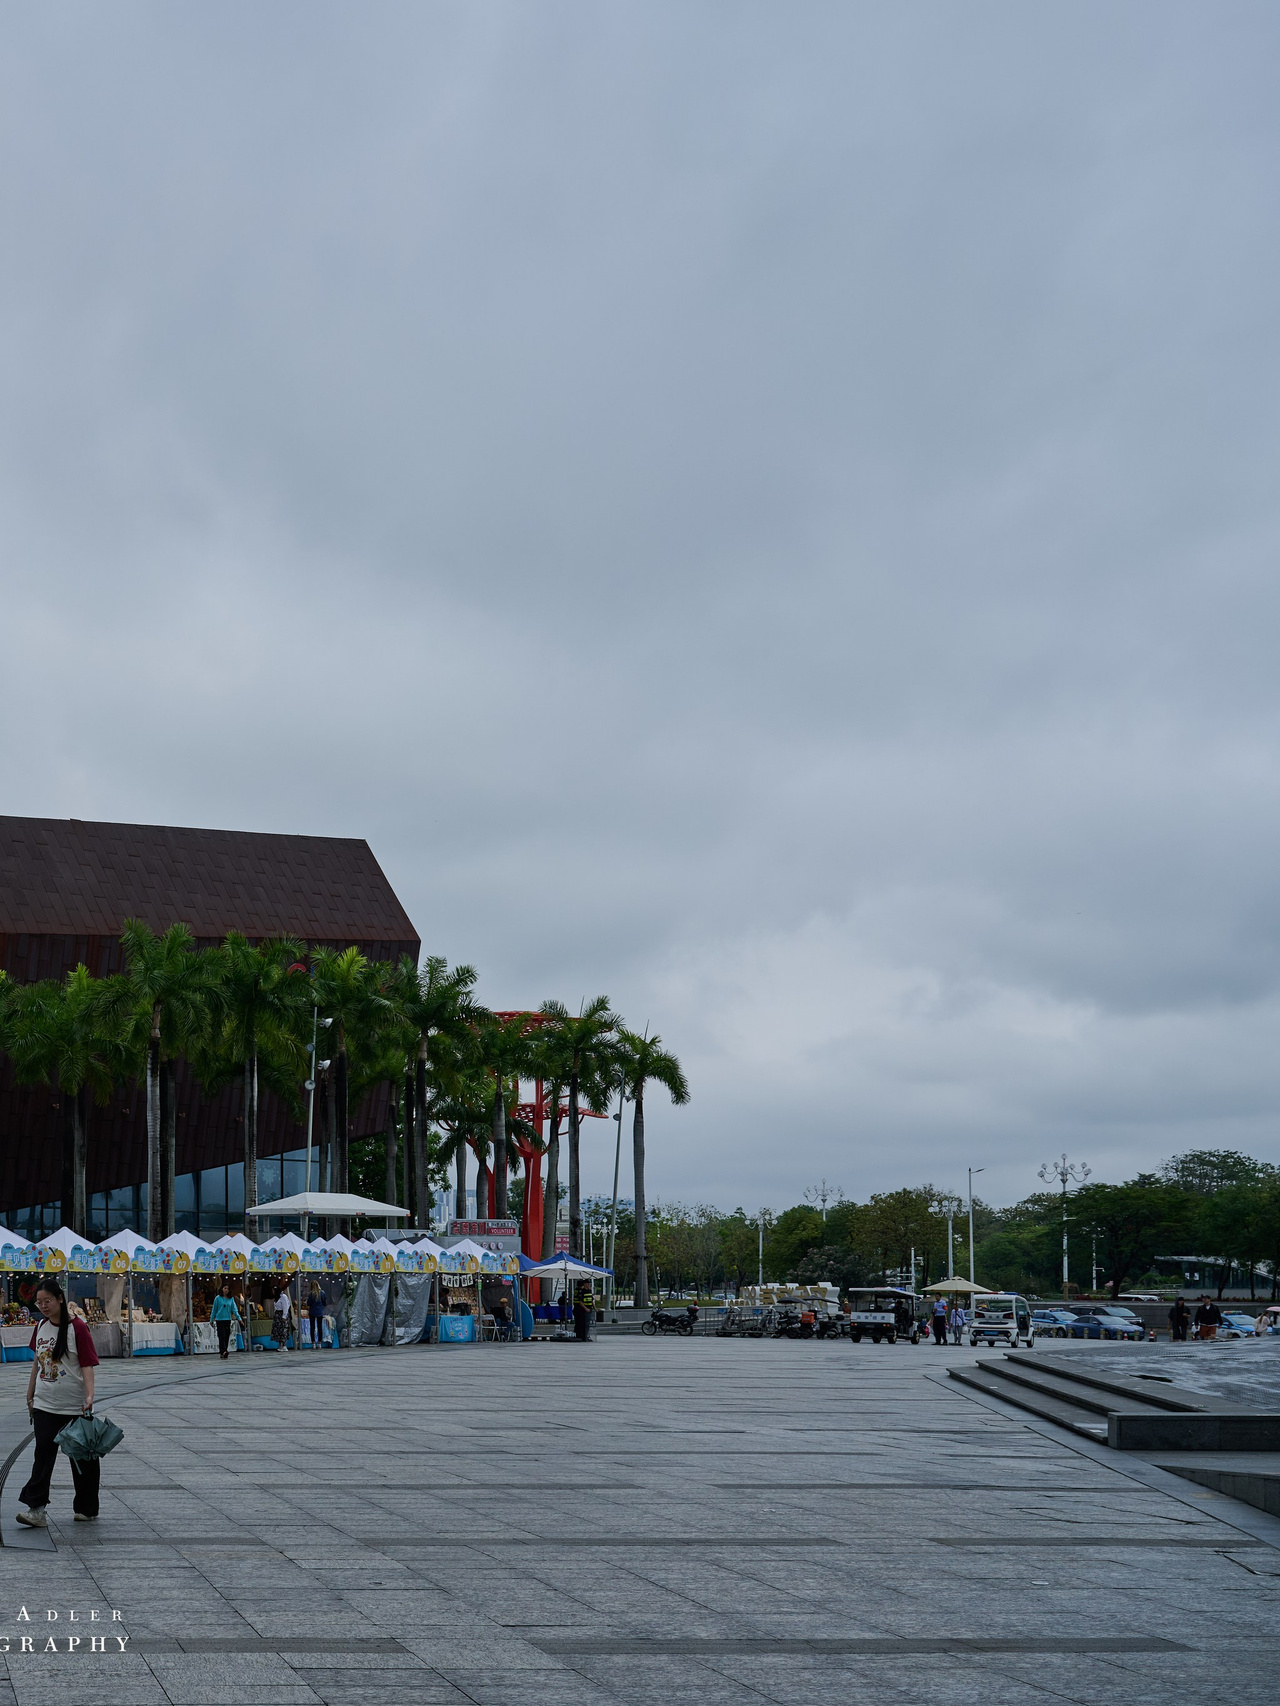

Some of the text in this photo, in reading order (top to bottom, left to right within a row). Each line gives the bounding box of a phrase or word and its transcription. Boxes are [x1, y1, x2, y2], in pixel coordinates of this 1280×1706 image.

[51, 1258, 62, 1267] 05
[115, 1261, 126, 1269] 06
[234, 1261, 244, 1269] 08
[287, 1260, 297, 1268] 09
[339, 1260, 346, 1268] 10
[385, 1261, 391, 1269] 11
[470, 1262, 476, 1270] 13
